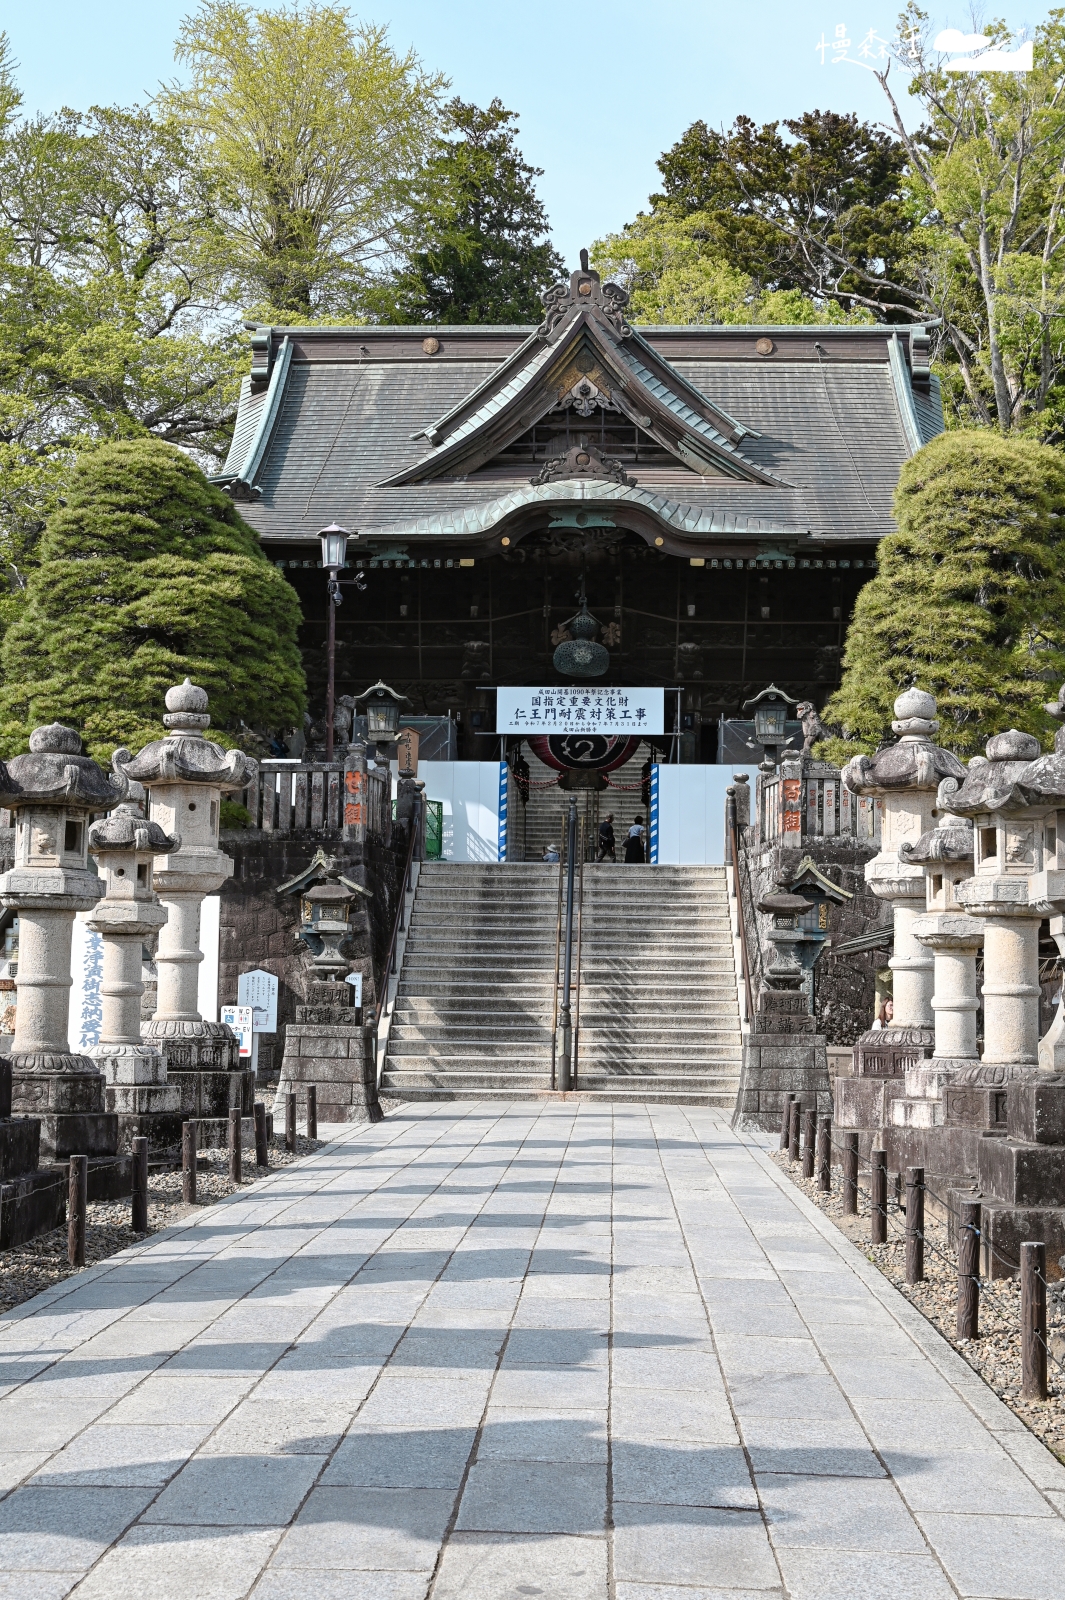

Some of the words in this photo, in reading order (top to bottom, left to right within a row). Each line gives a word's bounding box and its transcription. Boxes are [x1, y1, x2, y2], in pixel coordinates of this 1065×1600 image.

[531, 696, 629, 707] 国指定重要文化財
[514, 707, 647, 721] 仁王門耐震対策工事
